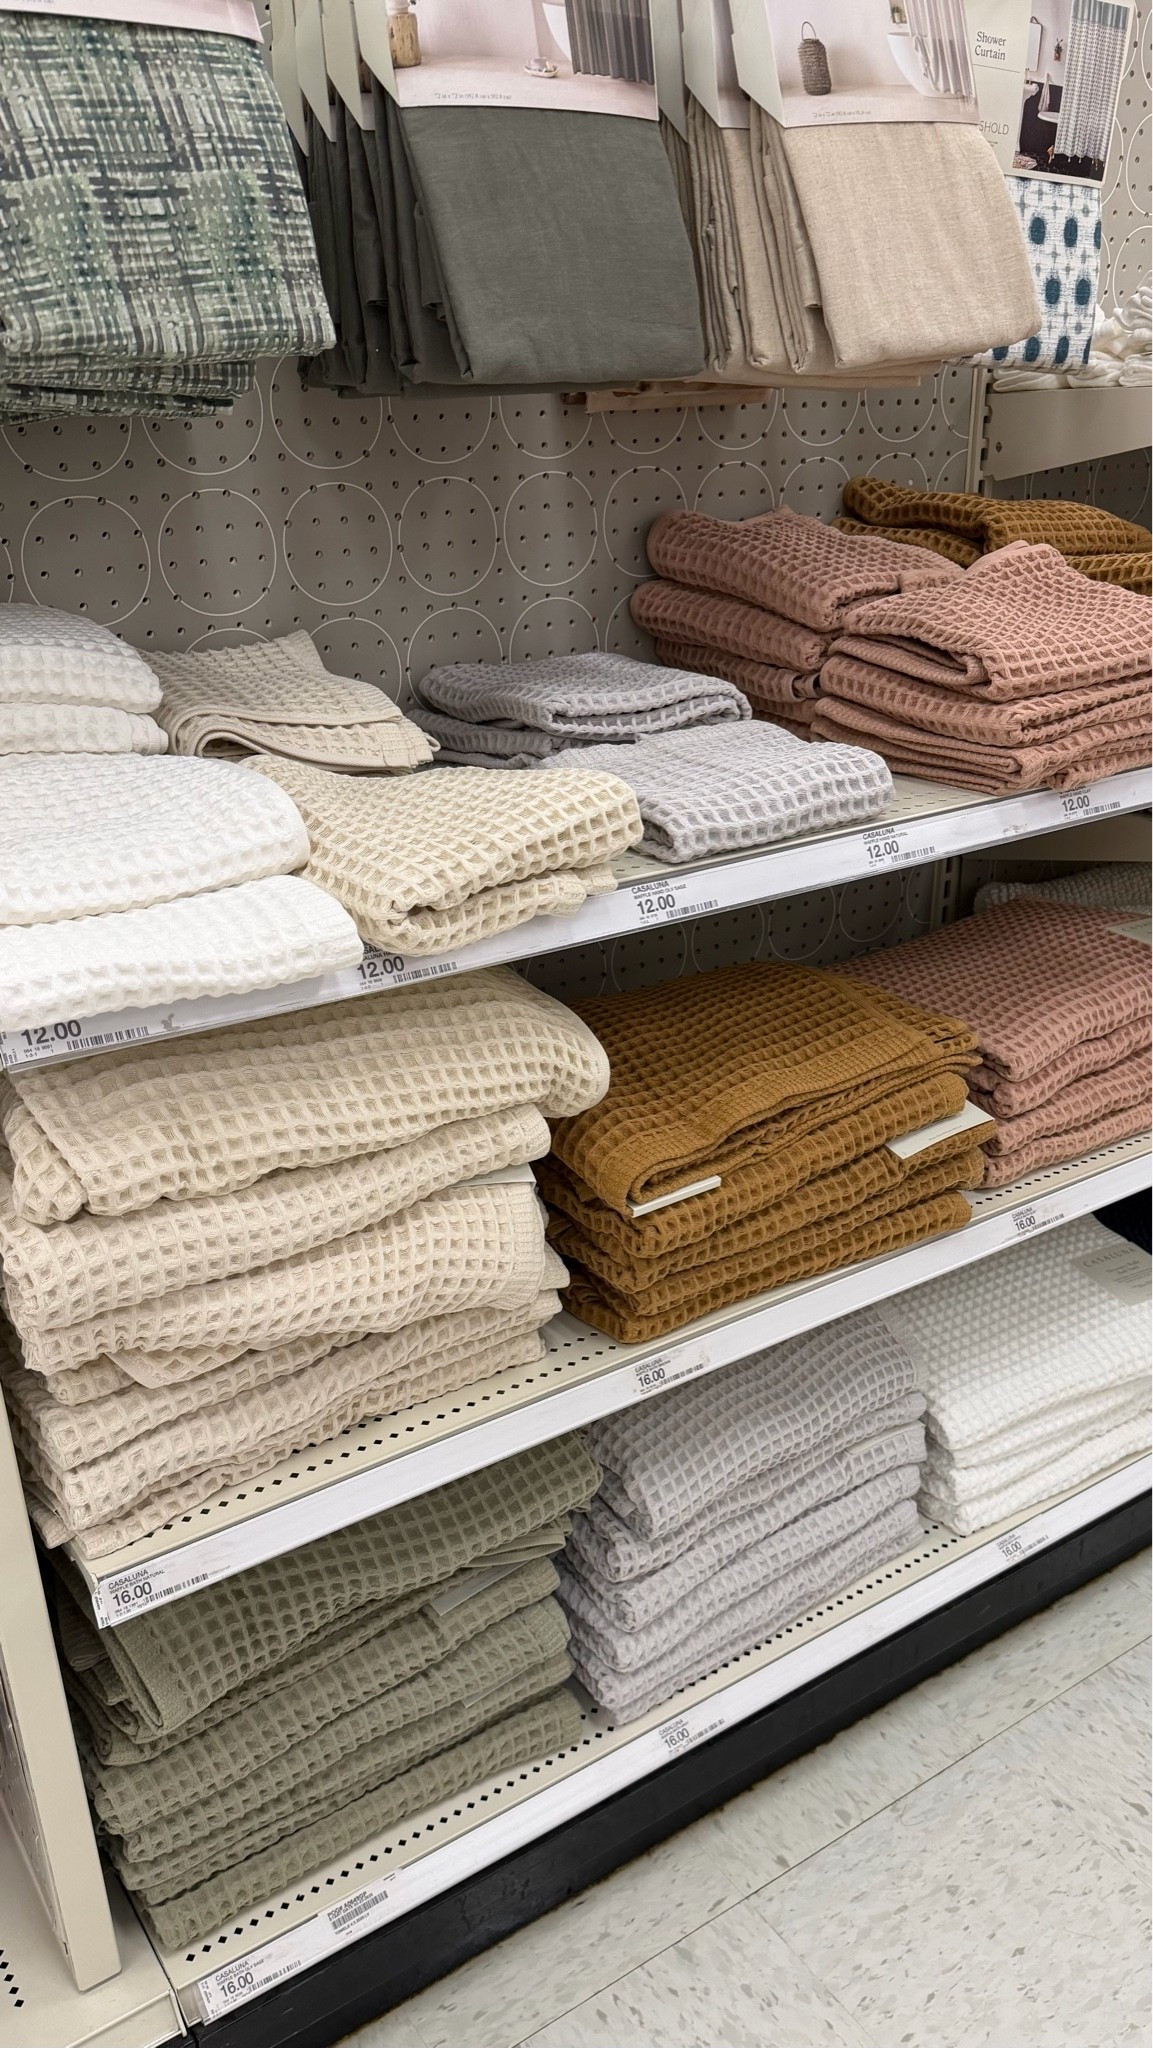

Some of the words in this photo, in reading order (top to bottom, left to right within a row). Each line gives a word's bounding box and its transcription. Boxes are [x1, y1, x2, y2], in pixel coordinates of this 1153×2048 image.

[976, 31, 1006, 46] Shower
[974, 45, 1006, 61] Curtain
[979, 120, 1009, 135] SHOLD
[1062, 795, 1090, 812] 12.00
[862, 827, 895, 840] CASALUNA
[866, 840, 899, 859] 12.00
[631, 880, 670, 894] CASALUNA
[637, 894, 676, 914] 12.00
[363, 953, 383, 961] ALUNA
[357, 956, 404, 979] 12.00
[21, 1019, 82, 1046] 12.00
[1011, 1207, 1033, 1219] CASALUNA
[1015, 1215, 1036, 1231] 16.00
[634, 1358, 663, 1373] CASALUNA
[638, 1367, 666, 1387] 16.00
[1002, 1541, 1022, 1557] 16.00
[108, 1569, 148, 1590] CASALUNA
[109, 1583, 128, 1594] WAFFLE
[113, 1582, 152, 1607] 16.00
[659, 1719, 684, 1736] CASALUNA
[664, 1727, 690, 1748] 16.00
[215, 1960, 249, 1982] CASALUNA
[217, 1975, 233, 1986] WAFFLE
[220, 1971, 254, 1997] 16.00
